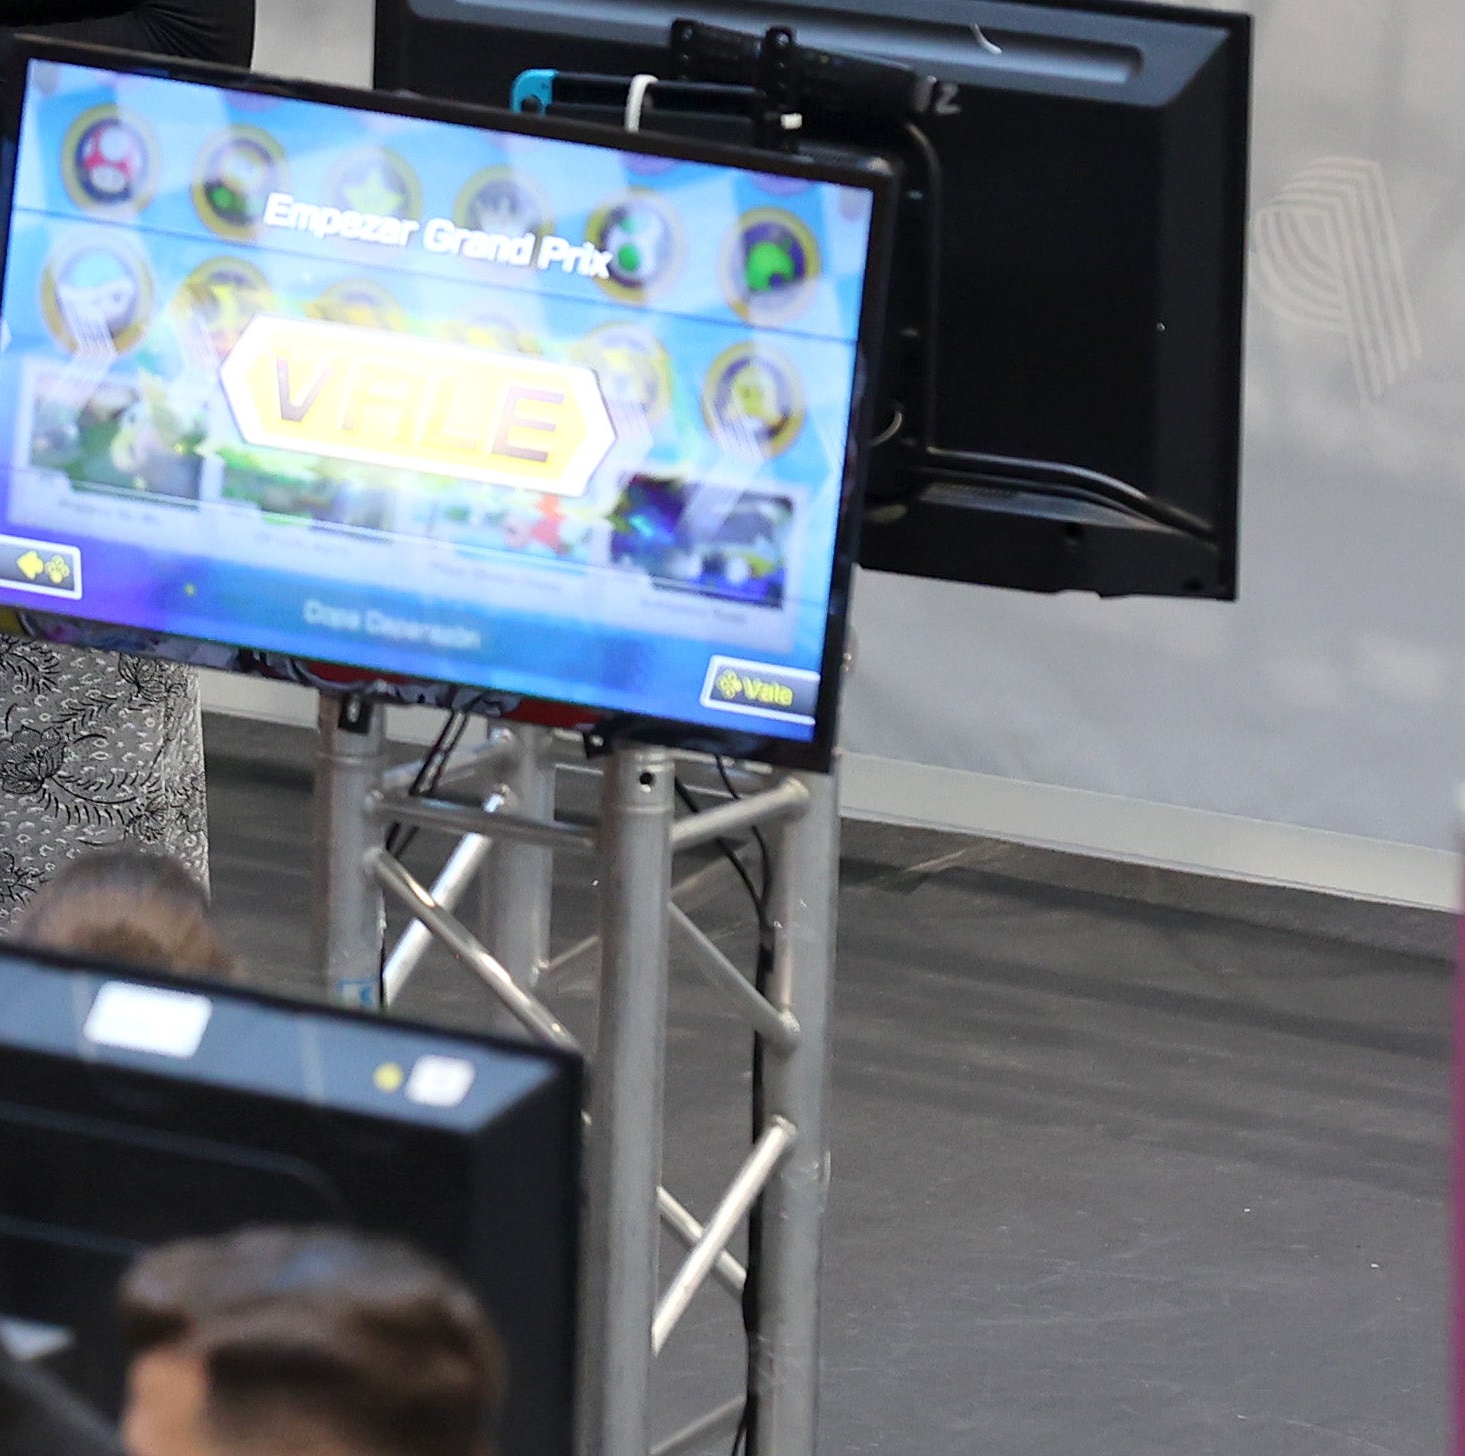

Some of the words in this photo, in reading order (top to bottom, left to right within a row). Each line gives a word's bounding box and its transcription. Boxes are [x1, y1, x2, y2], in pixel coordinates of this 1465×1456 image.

[264, 192, 419, 246] Empezar
[422, 218, 536, 267] Grand
[537, 235, 614, 279] Prix
[275, 358, 566, 463] VALE
[742, 676, 794, 706] Vale
